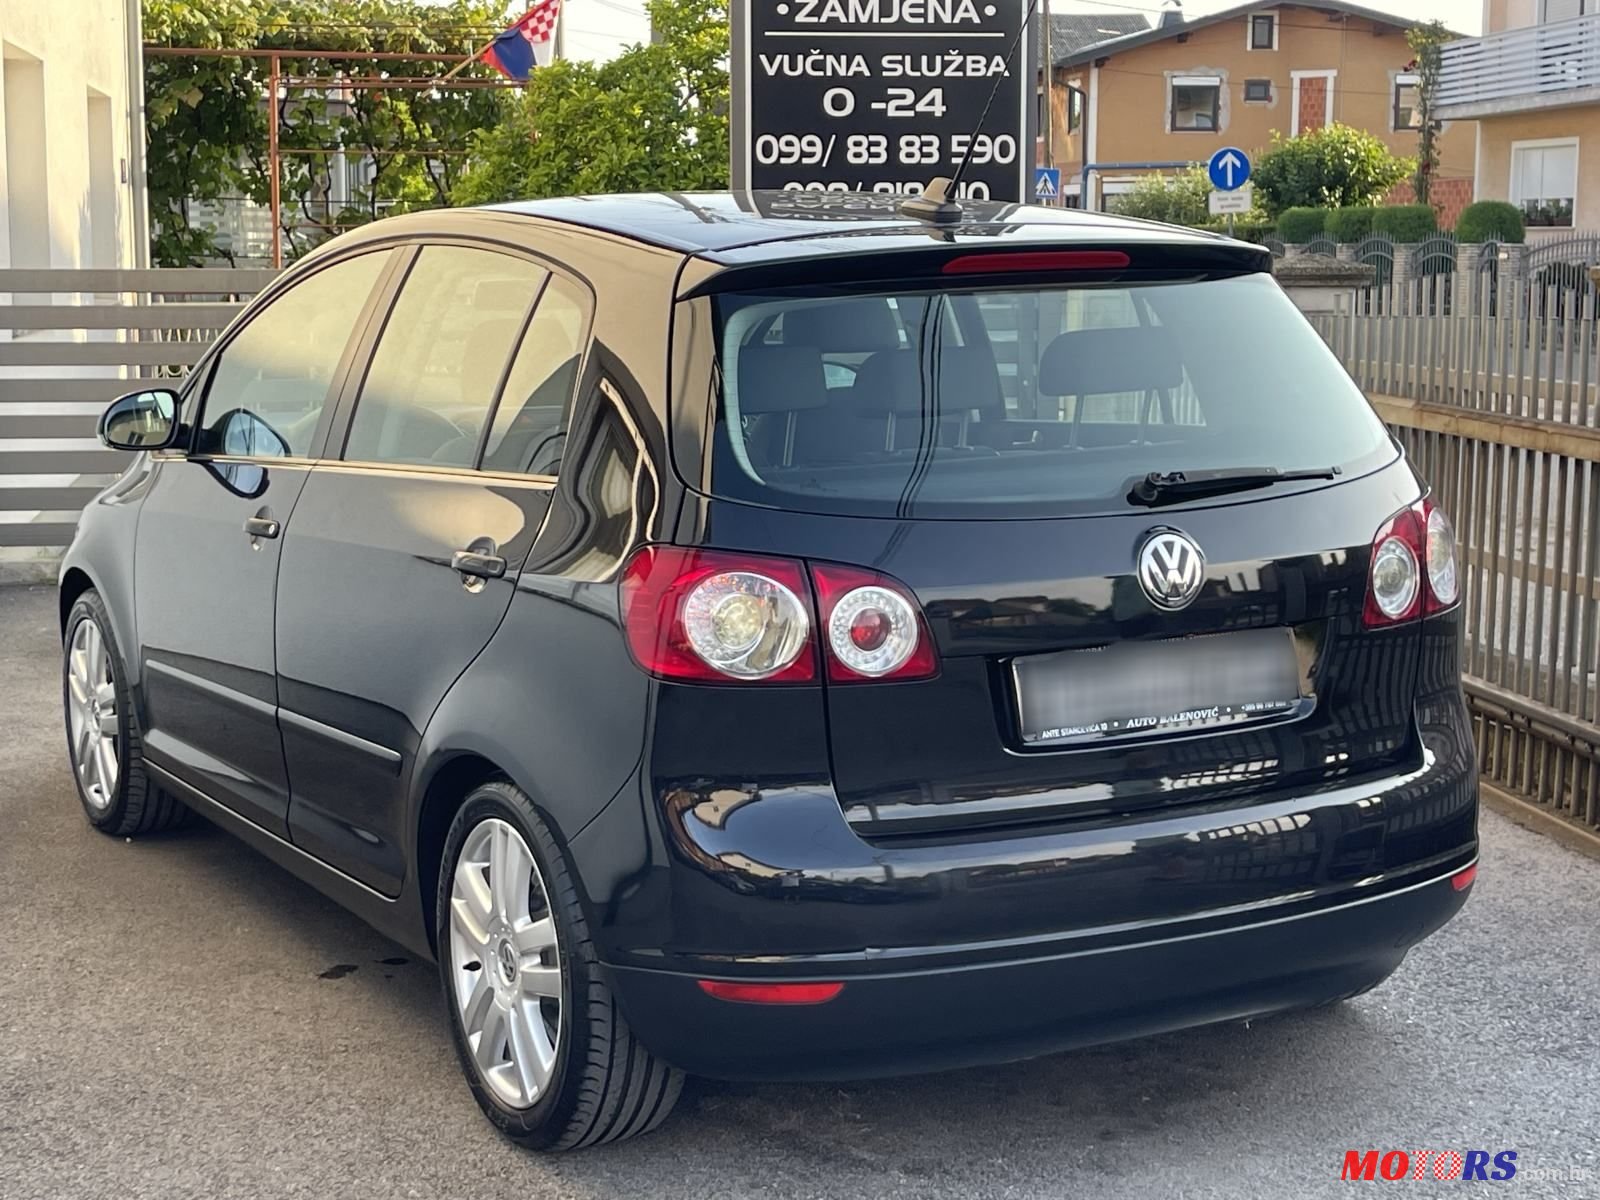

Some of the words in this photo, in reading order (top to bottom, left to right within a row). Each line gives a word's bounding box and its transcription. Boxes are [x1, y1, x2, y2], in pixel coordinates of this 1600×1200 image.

[794, 0, 981, 24] ZAMJENA
[759, 49, 871, 77] VUČNA
[881, 49, 1010, 77] SLUŽBA
[823, 87, 855, 117] 0
[756, 134, 837, 167] 099/
[847, 134, 888, 164] 83
[899, 134, 940, 165] 83
[951, 135, 1016, 165] 590
[1126, 717, 1157, 728] AUTO
